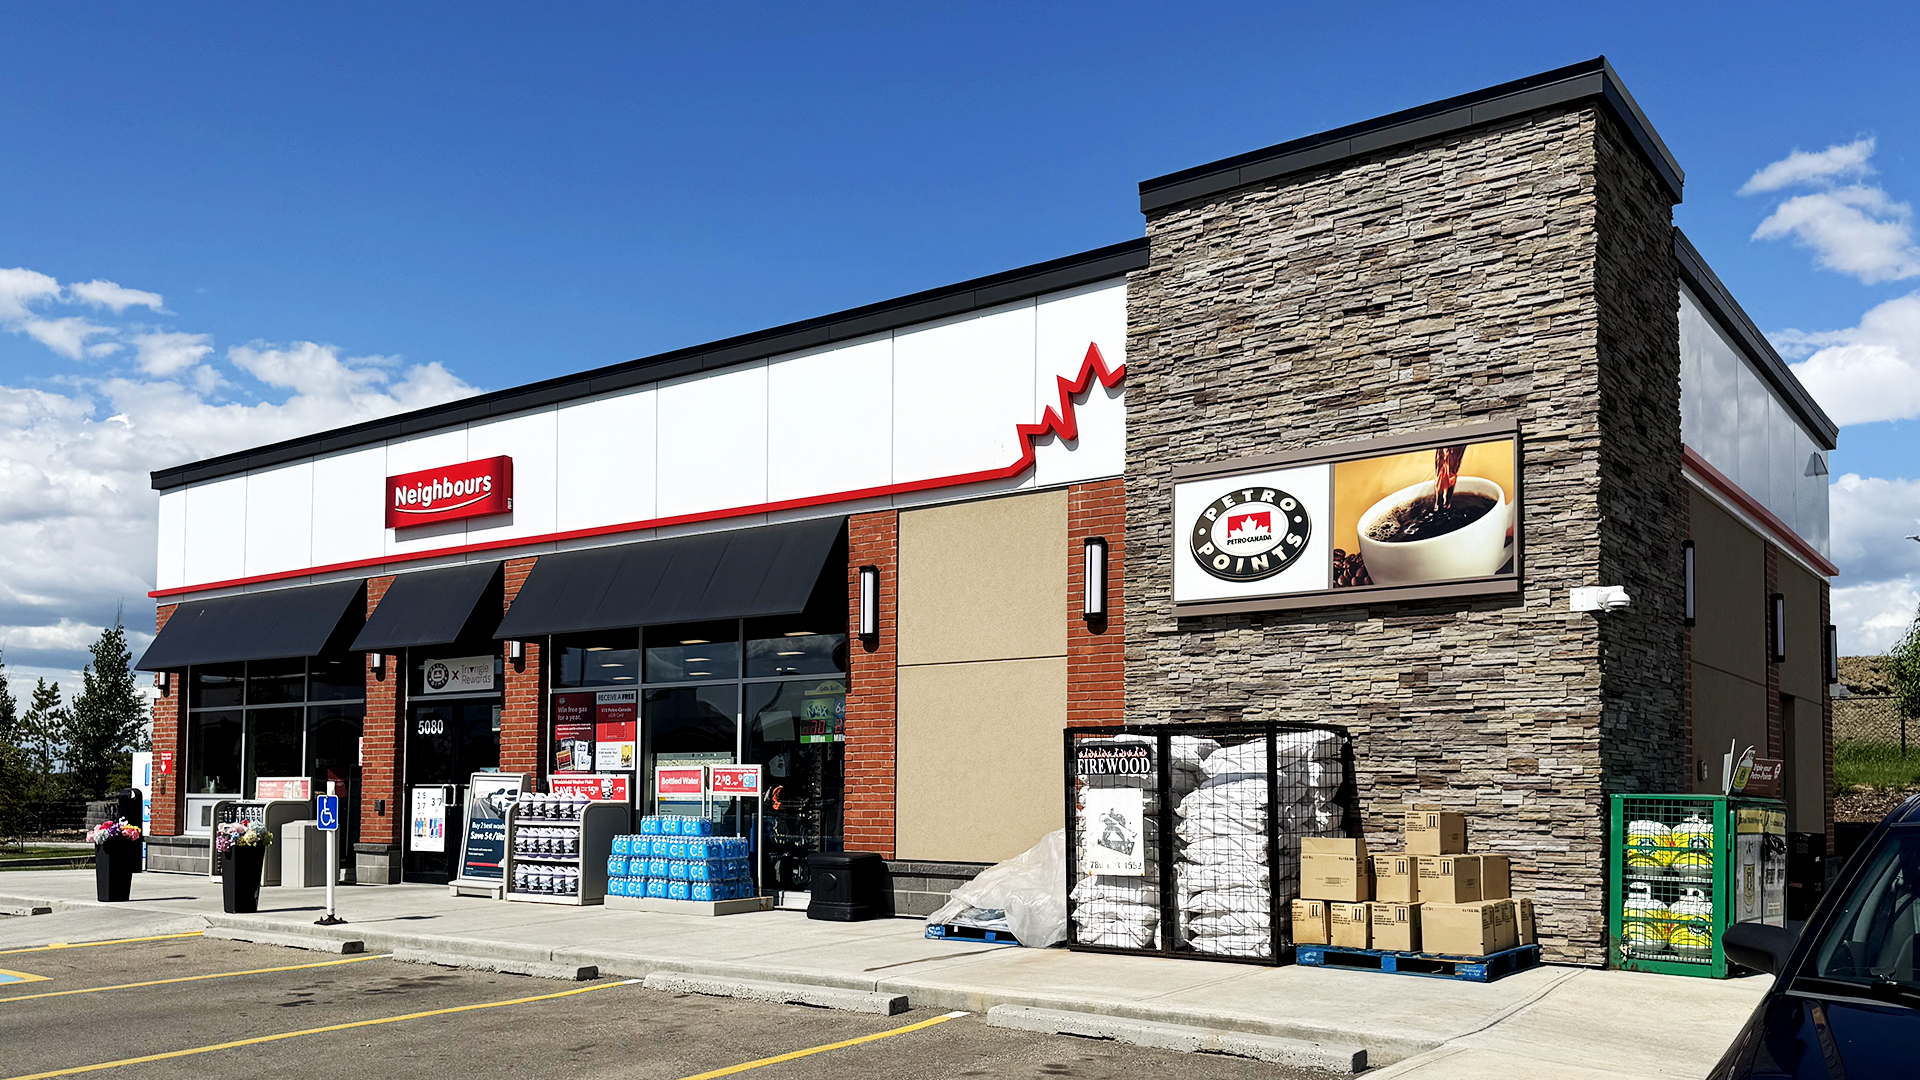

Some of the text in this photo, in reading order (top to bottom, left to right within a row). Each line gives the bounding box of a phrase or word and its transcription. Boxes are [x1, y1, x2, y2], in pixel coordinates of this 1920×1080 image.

[395, 475, 492, 508] Neighbours
[1203, 489, 1297, 522] PETRO
[1226, 534, 1272, 546] PETRO-CANADA
[1197, 532, 1303, 574] POINTS
[462, 674, 491, 684] Rewards
[418, 720, 443, 734] 5080
[1077, 758, 1150, 775] FIREWOOD
[555, 786, 572, 794] SAVE
[470, 831, 484, 840] Save
